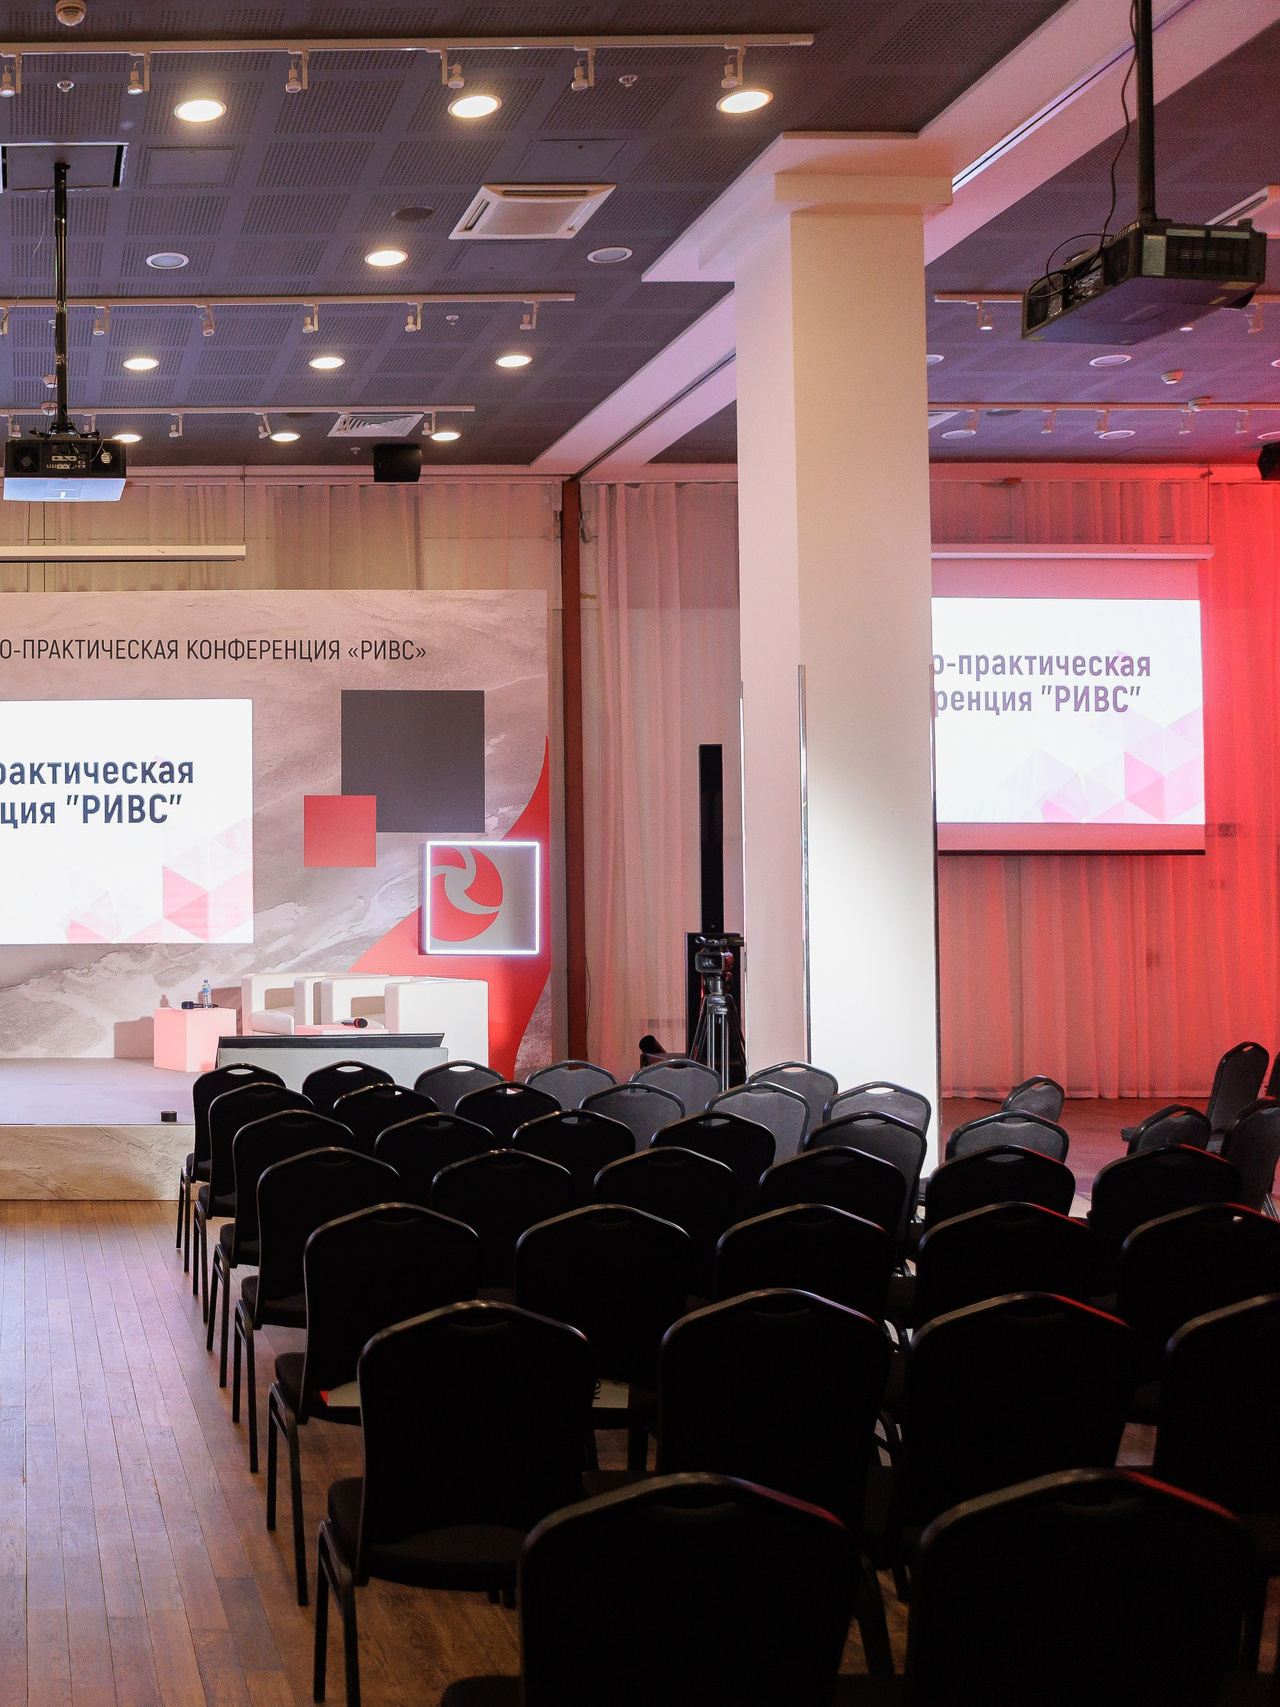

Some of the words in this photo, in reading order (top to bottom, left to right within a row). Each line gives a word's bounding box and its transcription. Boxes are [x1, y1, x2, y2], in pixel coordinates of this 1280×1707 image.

[187, 638, 340, 662] КОНФЕРЕНЦИЯ
[348, 640, 427, 660] «РИВС»
[933, 654, 1151, 681] о-практическая
[934, 690, 1032, 717] ренция
[1041, 685, 1141, 713] "РИВС"
[66, 793, 182, 825] "РИВС"
